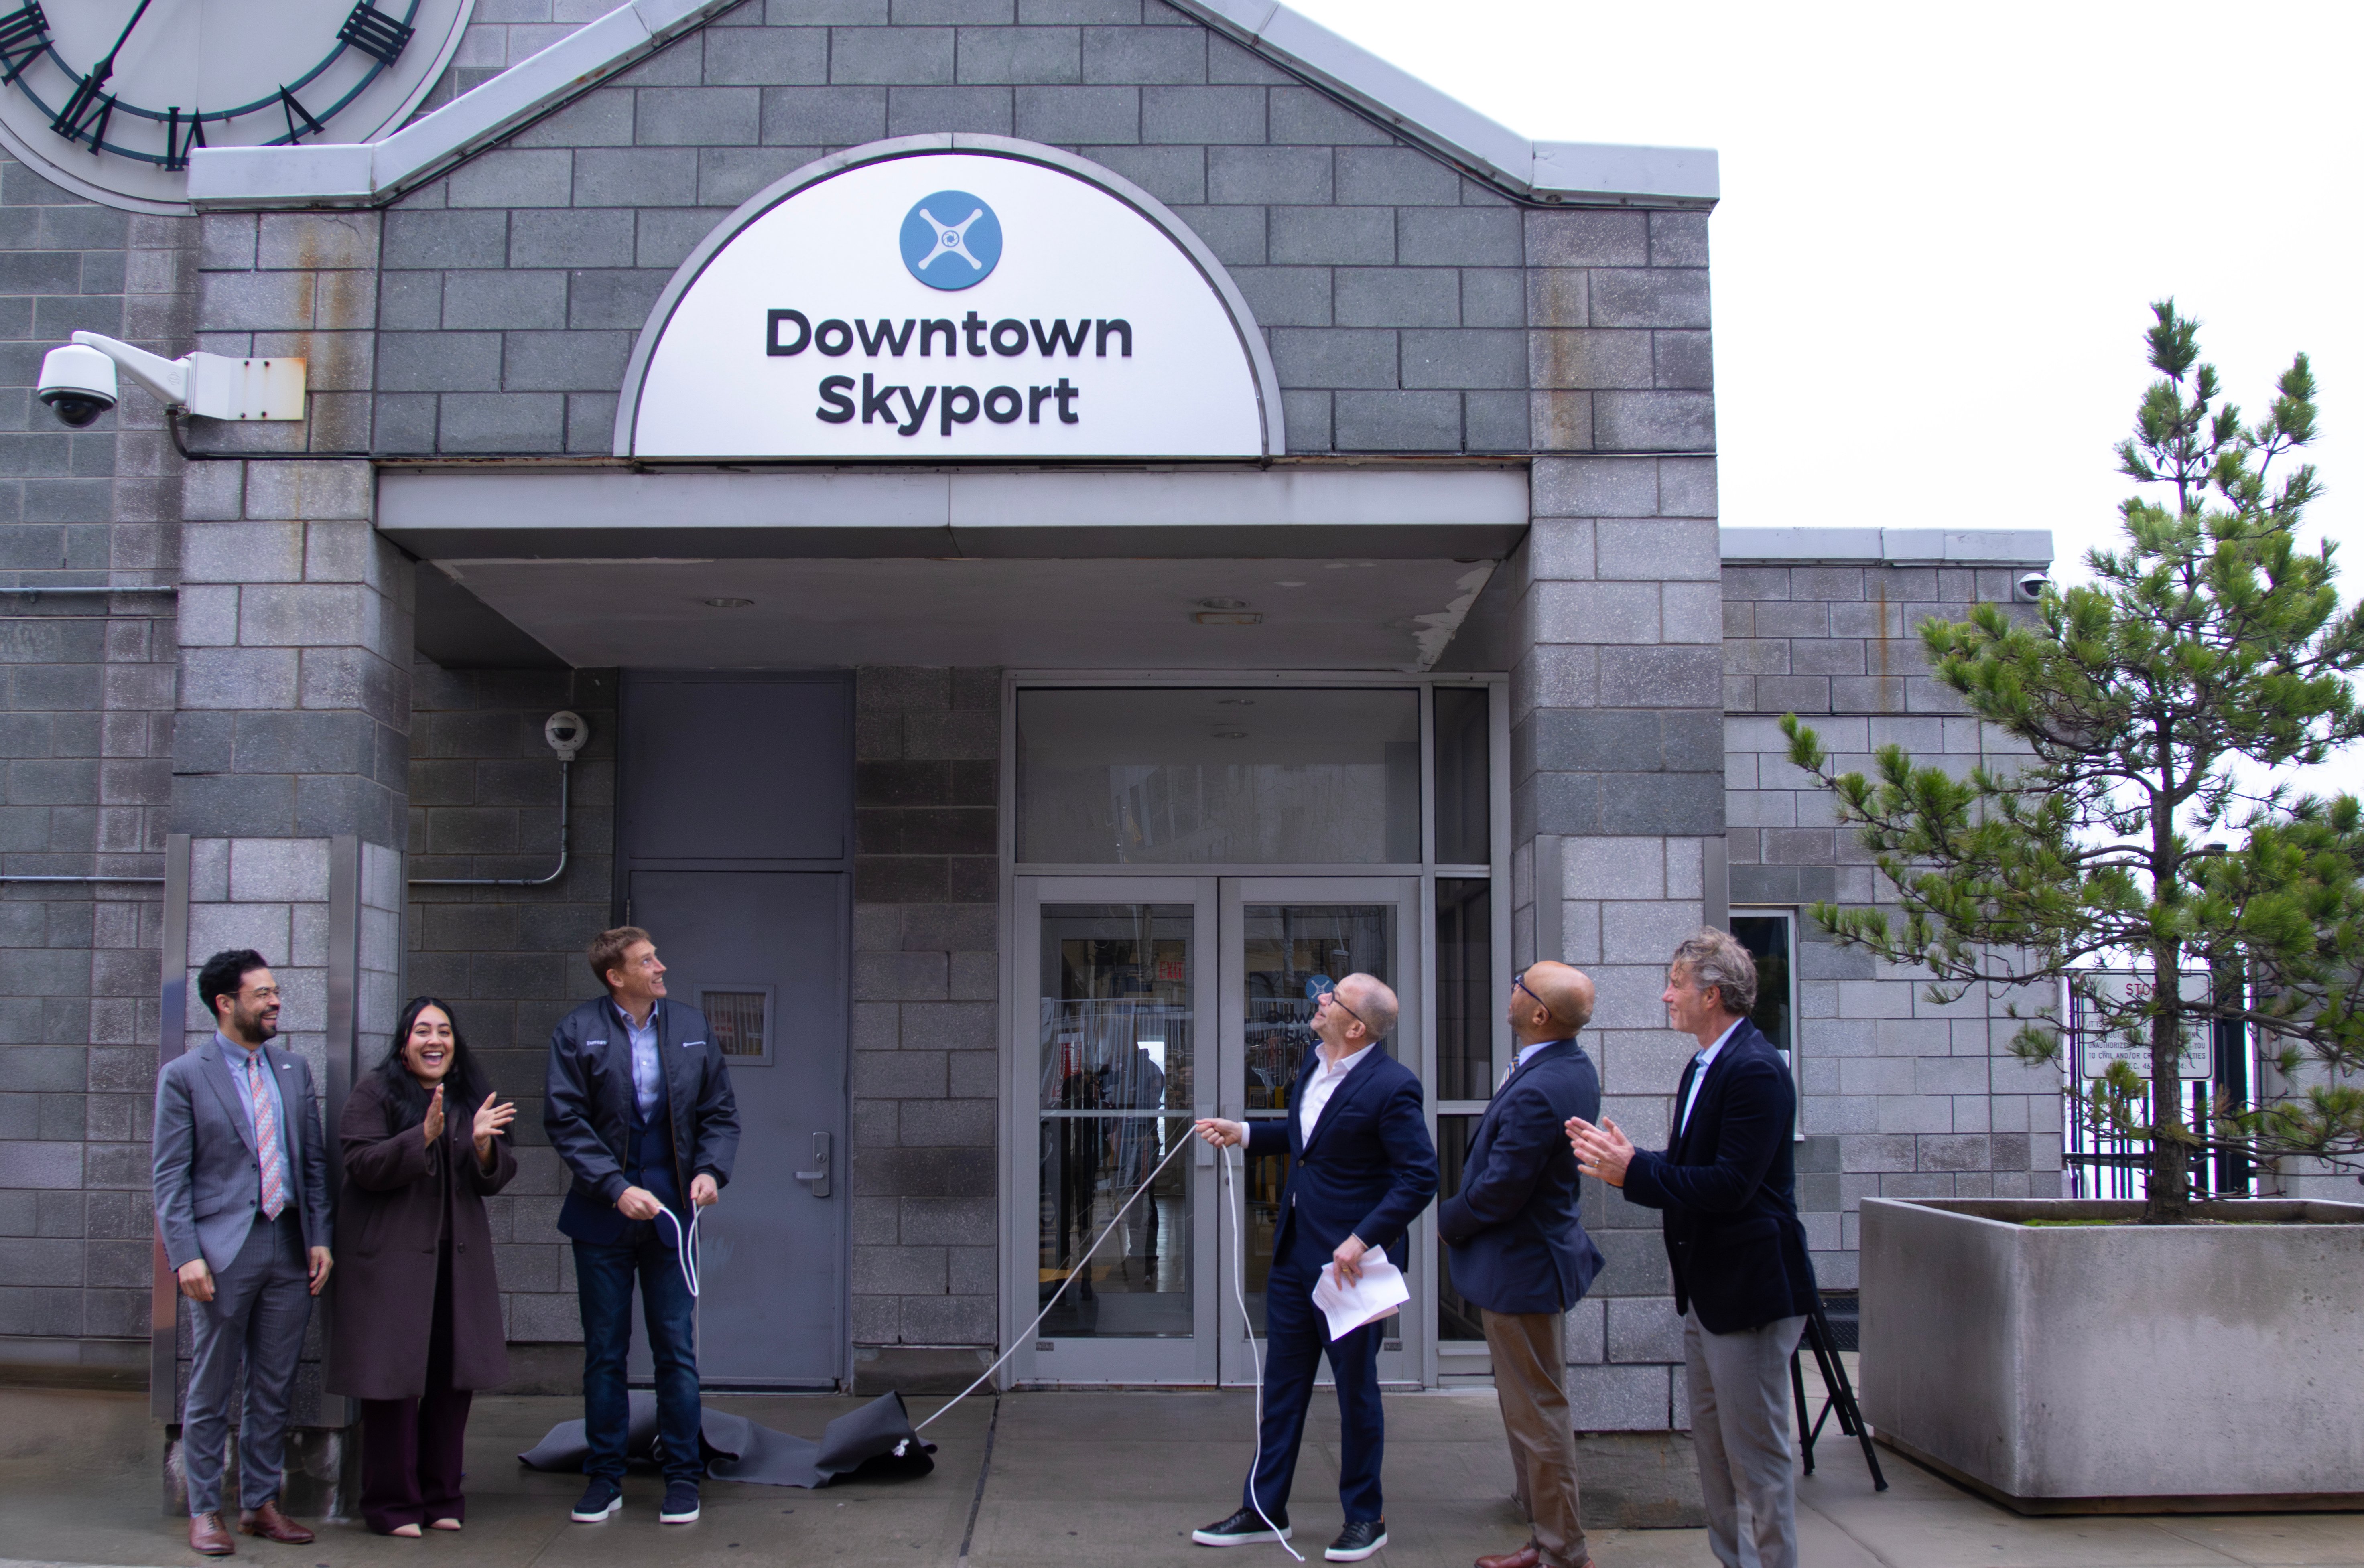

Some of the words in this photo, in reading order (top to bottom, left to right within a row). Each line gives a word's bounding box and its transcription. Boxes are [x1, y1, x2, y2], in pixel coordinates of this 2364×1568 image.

[767, 309, 1132, 357] Downtown
[816, 373, 1079, 436] Skyport
[1158, 961, 1185, 980] EXIT
